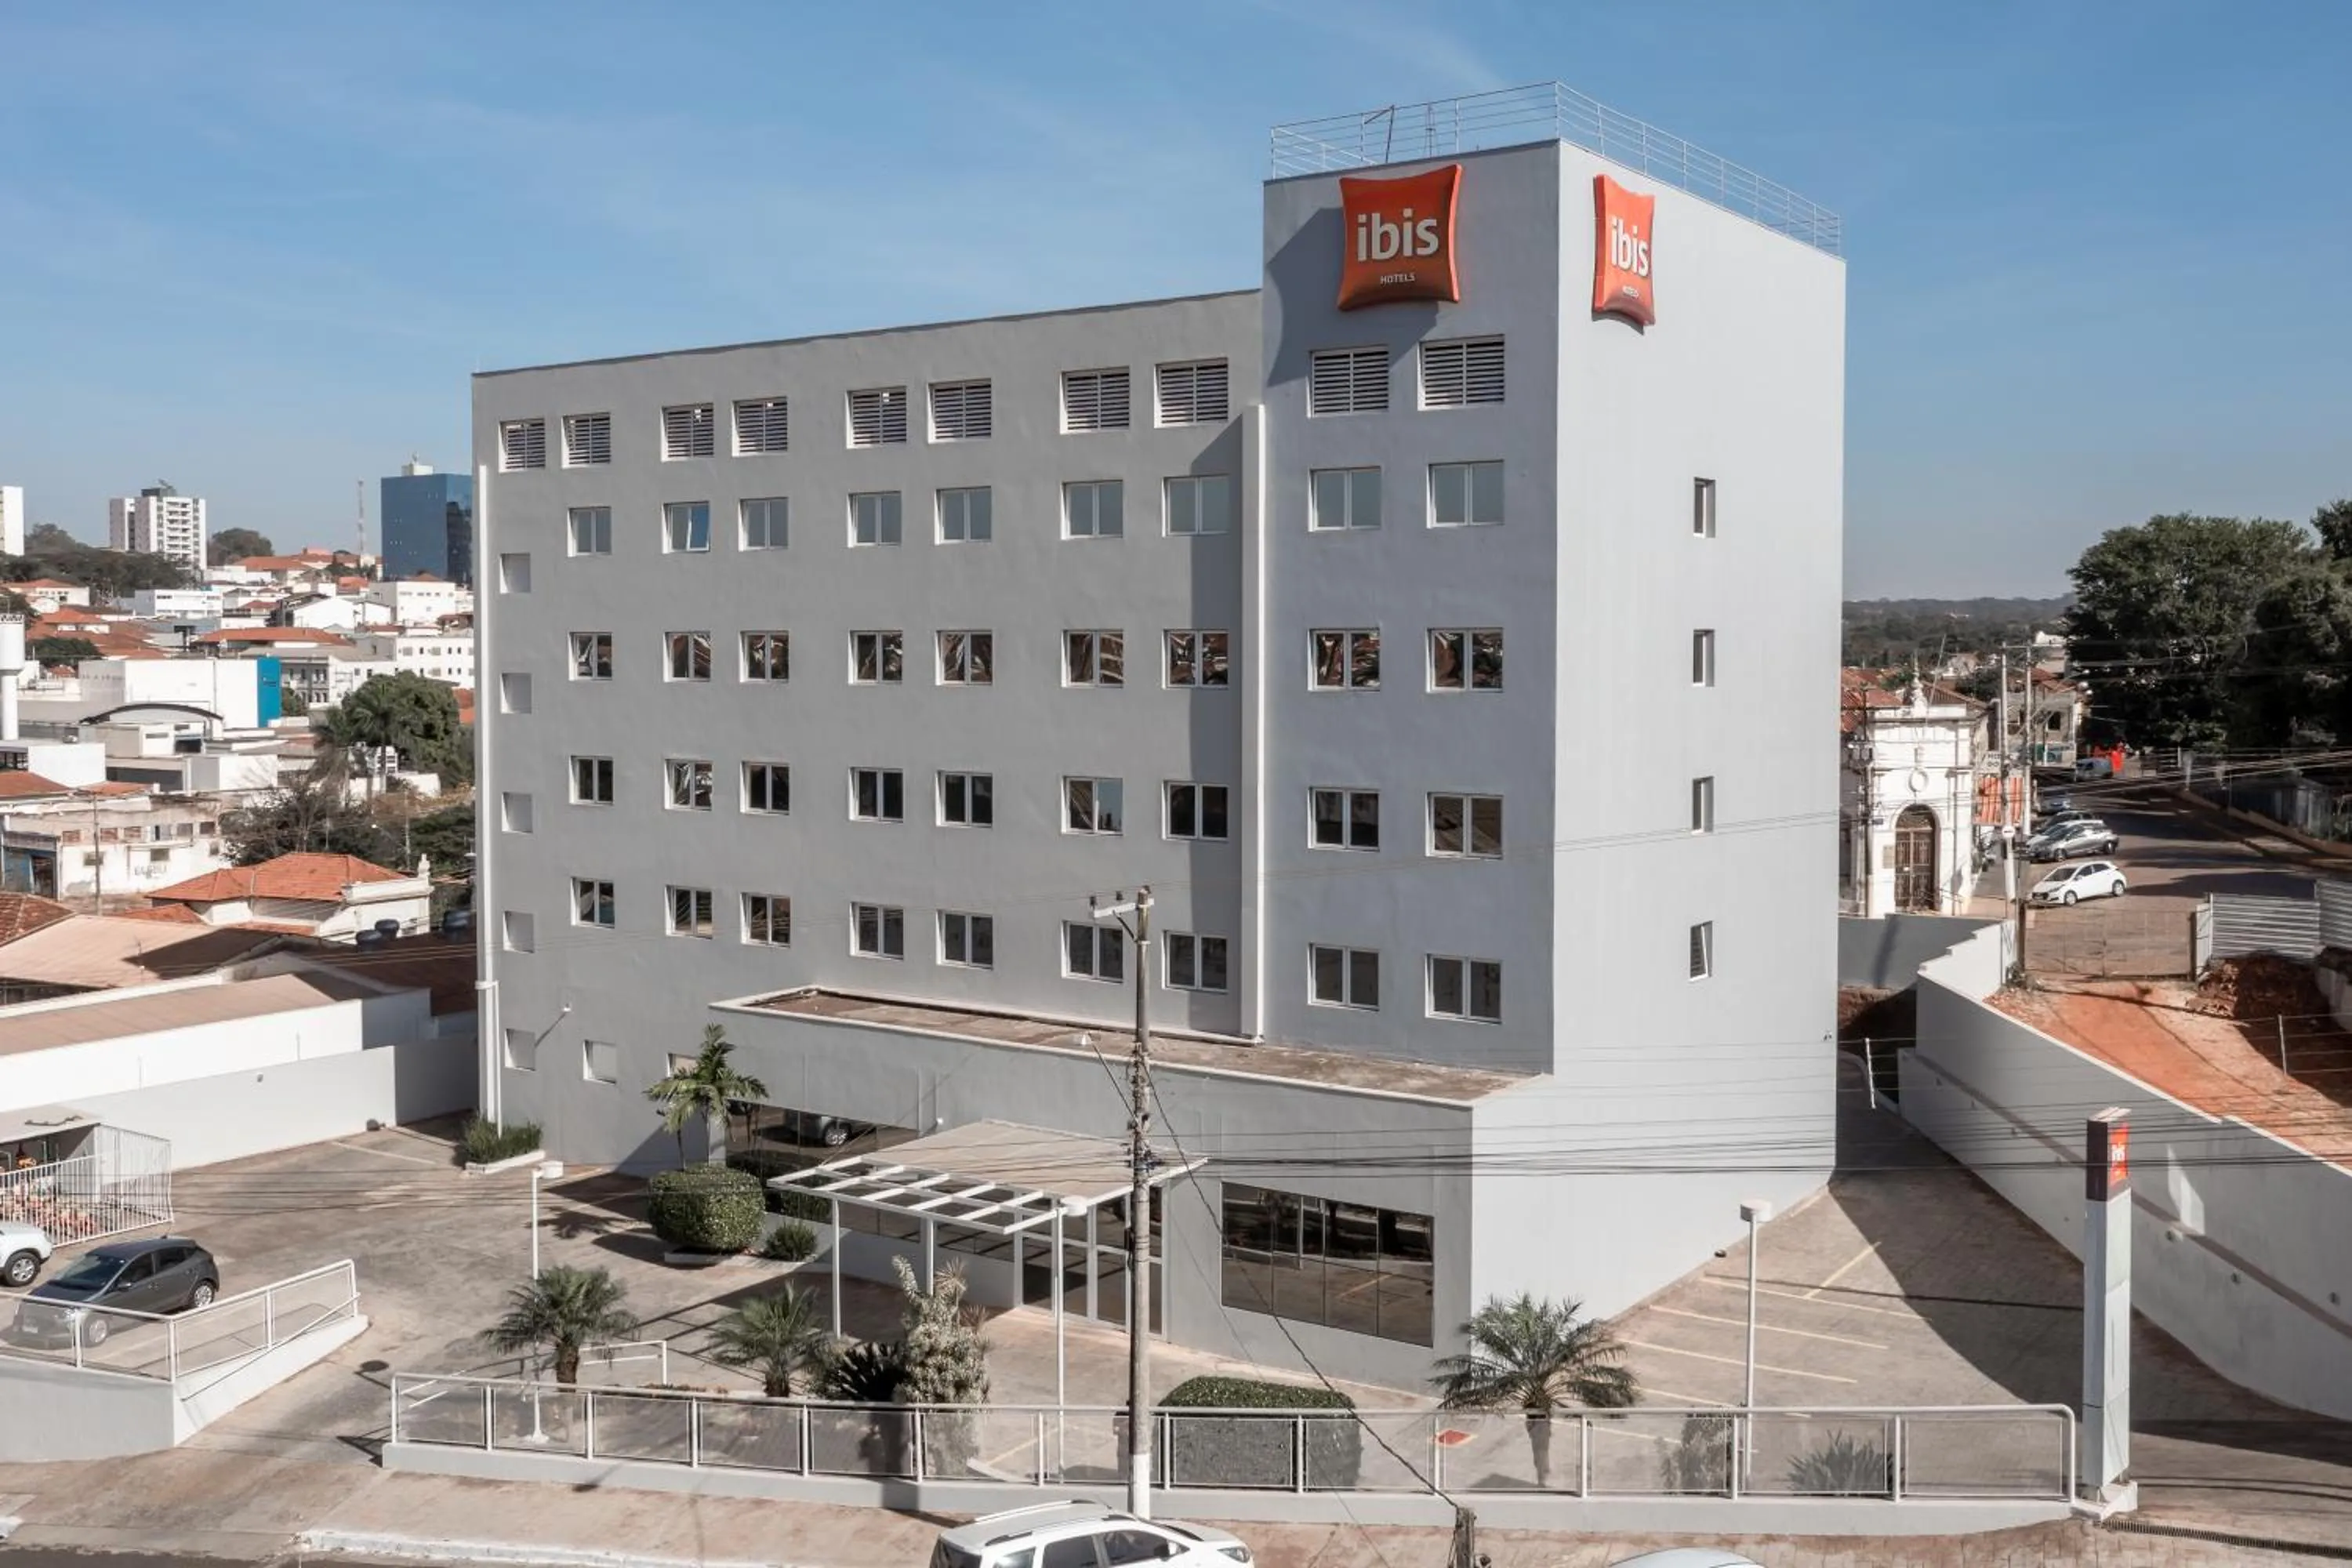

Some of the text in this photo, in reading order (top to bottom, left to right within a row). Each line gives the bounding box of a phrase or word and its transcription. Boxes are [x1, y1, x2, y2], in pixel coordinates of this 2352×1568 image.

[1357, 208, 1439, 262] ibis
[1611, 216, 1649, 277] ibis
[1380, 272, 1415, 285] HOTELS
